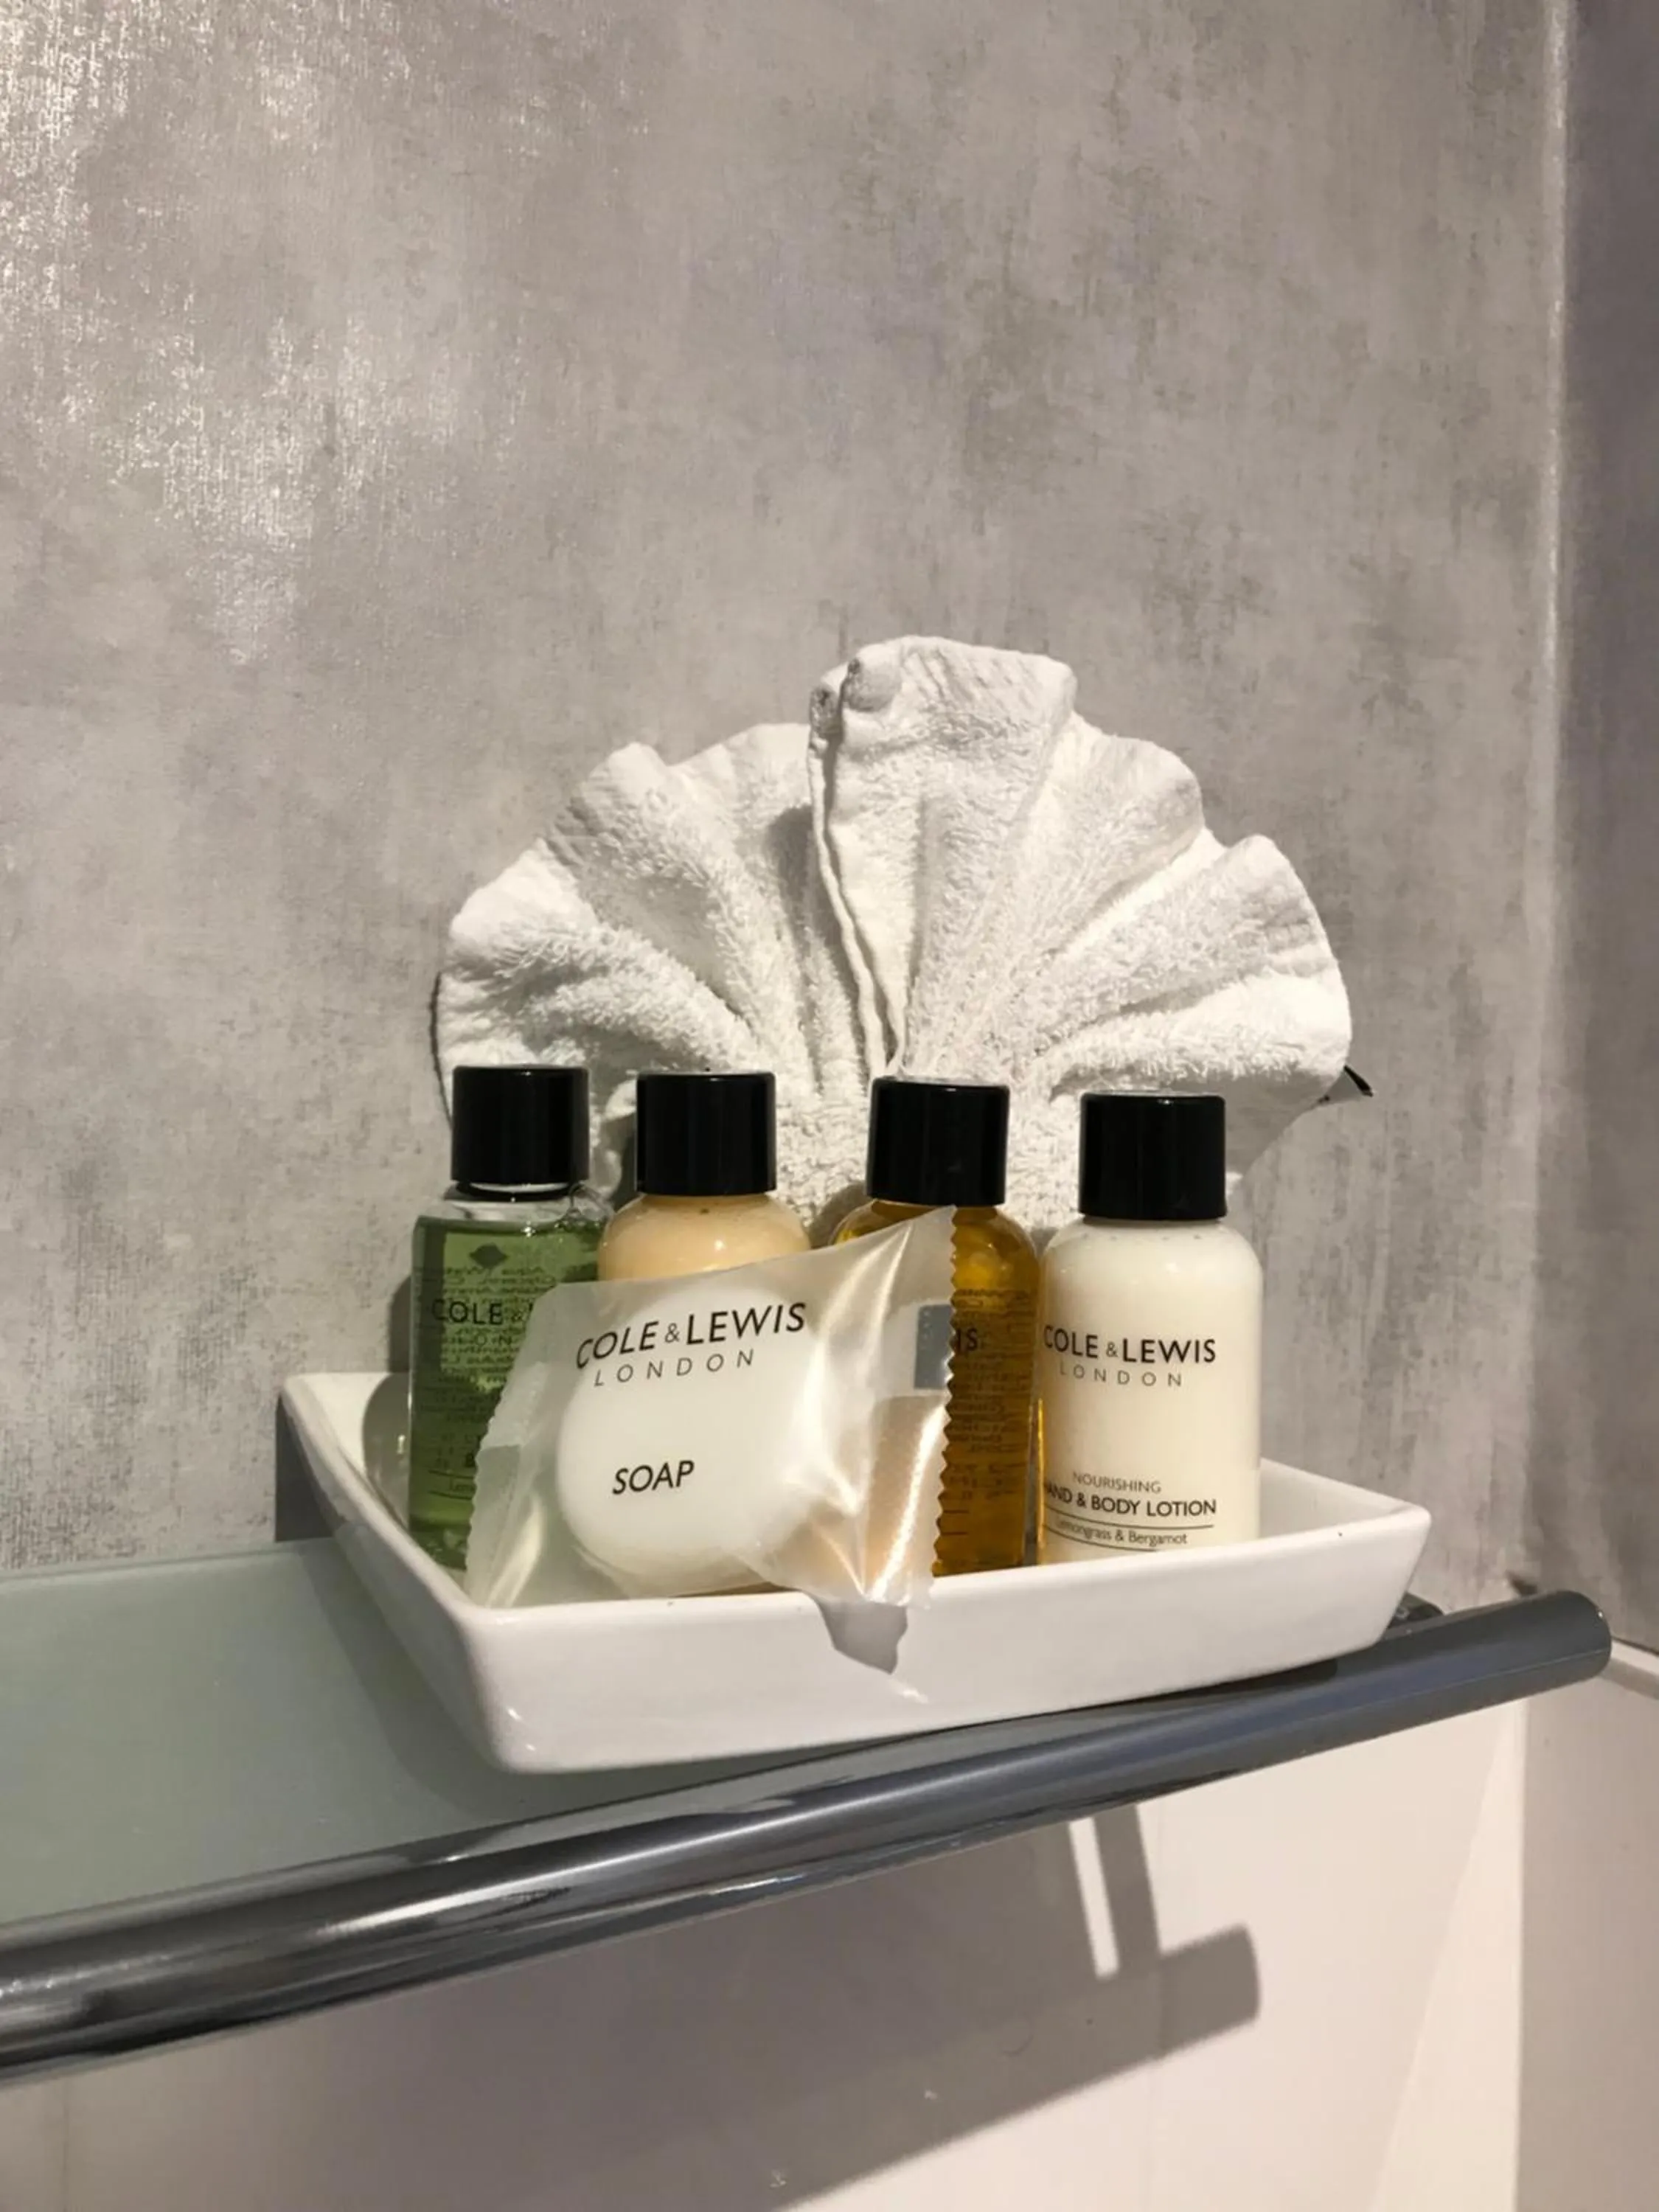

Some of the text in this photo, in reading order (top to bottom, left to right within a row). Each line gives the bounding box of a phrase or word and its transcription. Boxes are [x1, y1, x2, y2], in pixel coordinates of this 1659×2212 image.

[594, 1349, 754, 1387] LONDON
[1059, 1362, 1181, 1387] LONDON
[612, 1460, 695, 1495] SOAP
[1073, 1472, 1161, 1494] NOURISHING
[1077, 1492, 1087, 1508] &
[1091, 1494, 1141, 1516] BODY
[1147, 1498, 1216, 1517] LOTION
[1115, 1528, 1124, 1542] &
[1128, 1530, 1187, 1547] Bergamot
